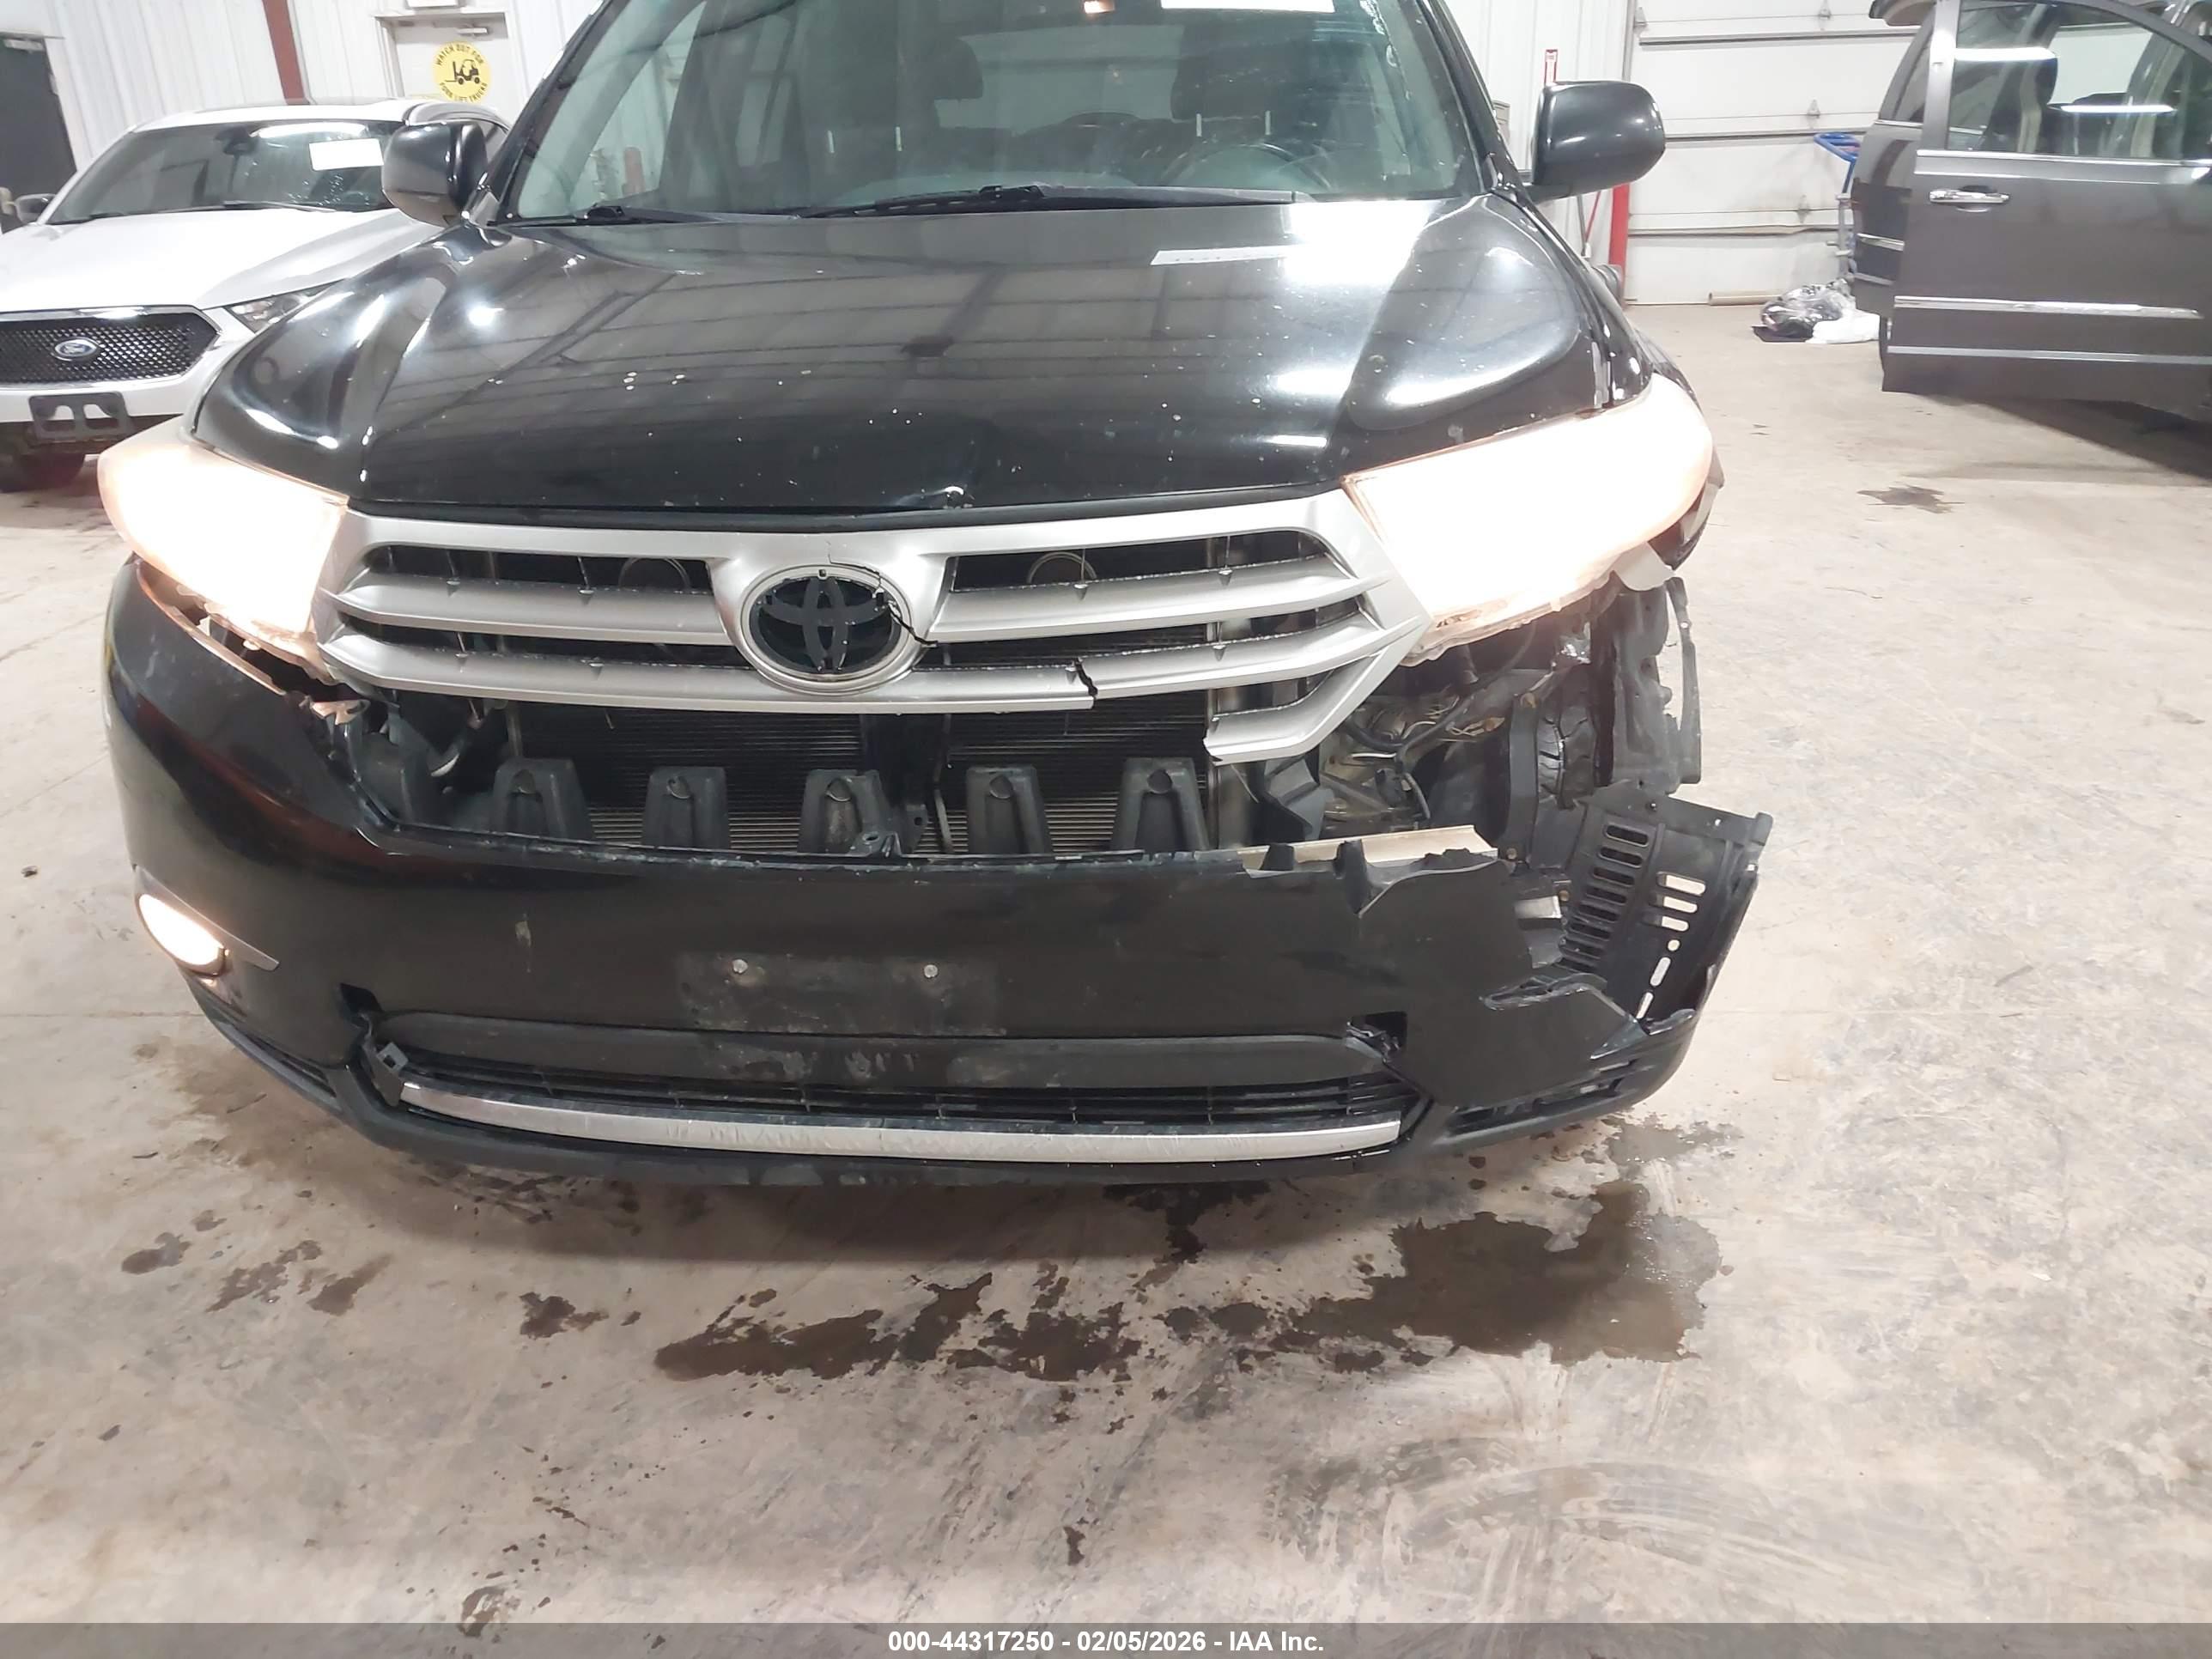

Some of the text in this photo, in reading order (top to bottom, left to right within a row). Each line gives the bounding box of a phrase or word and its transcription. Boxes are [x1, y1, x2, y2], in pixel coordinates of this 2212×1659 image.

[435, 44, 483, 66] WATCH OUT FOR
[440, 82, 453, 98] FORK
[470, 82, 487, 101] TRUCKS
